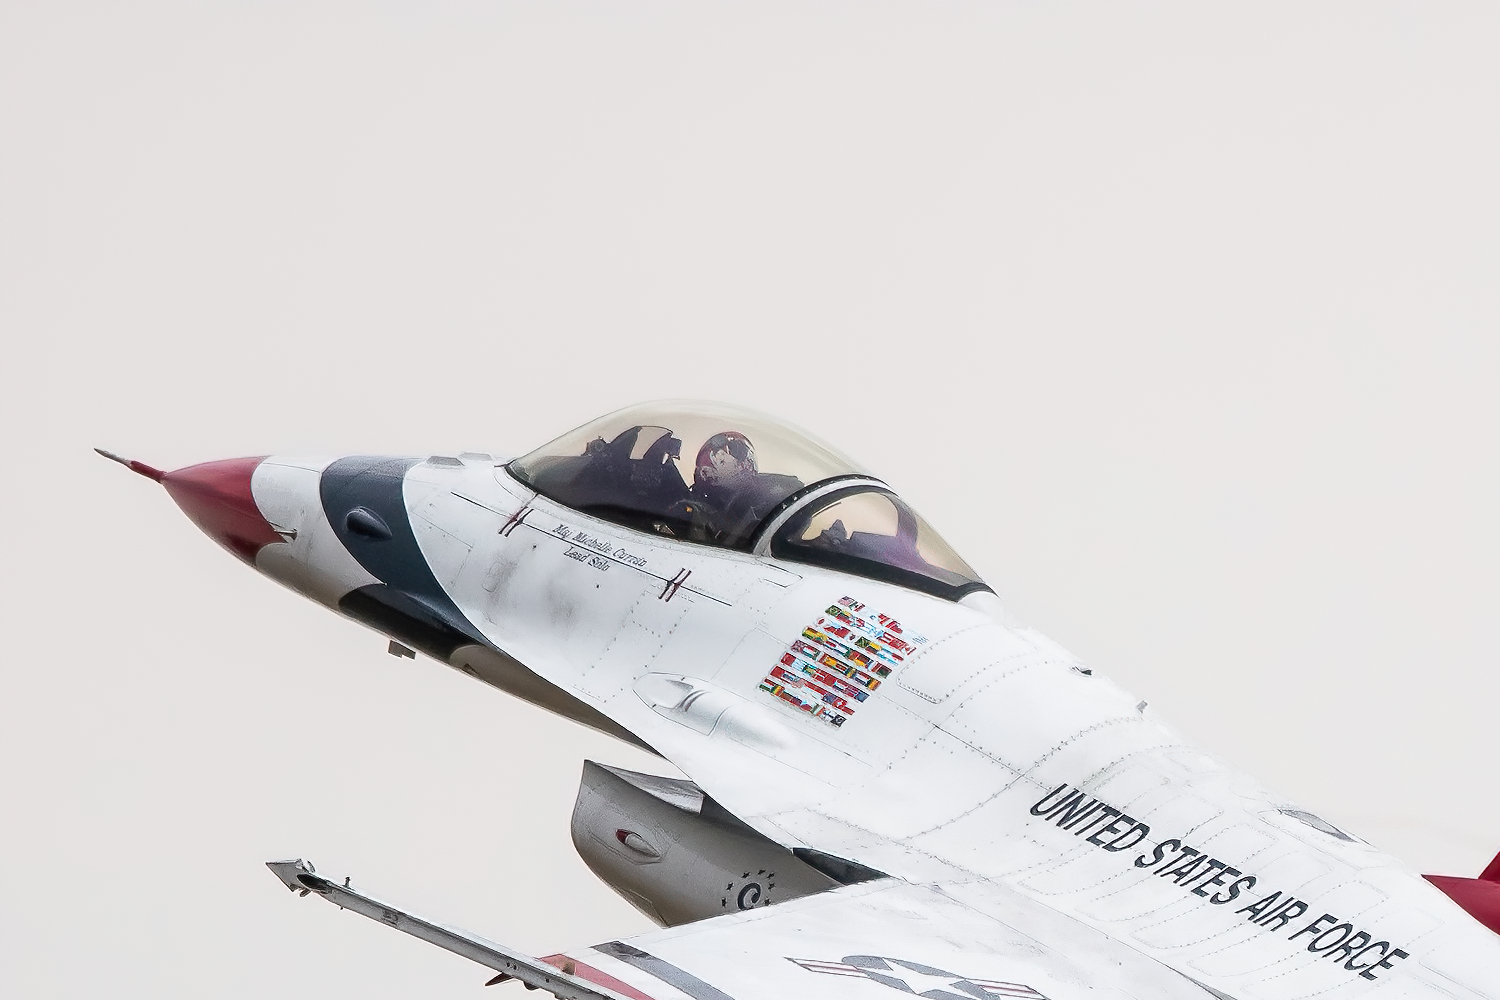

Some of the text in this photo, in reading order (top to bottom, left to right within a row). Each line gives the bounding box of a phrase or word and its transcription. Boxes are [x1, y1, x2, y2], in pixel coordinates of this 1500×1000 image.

[563, 546, 610, 571] Lead Solo
[1029, 783, 1410, 981] UNITED STATES AIR FORCE
